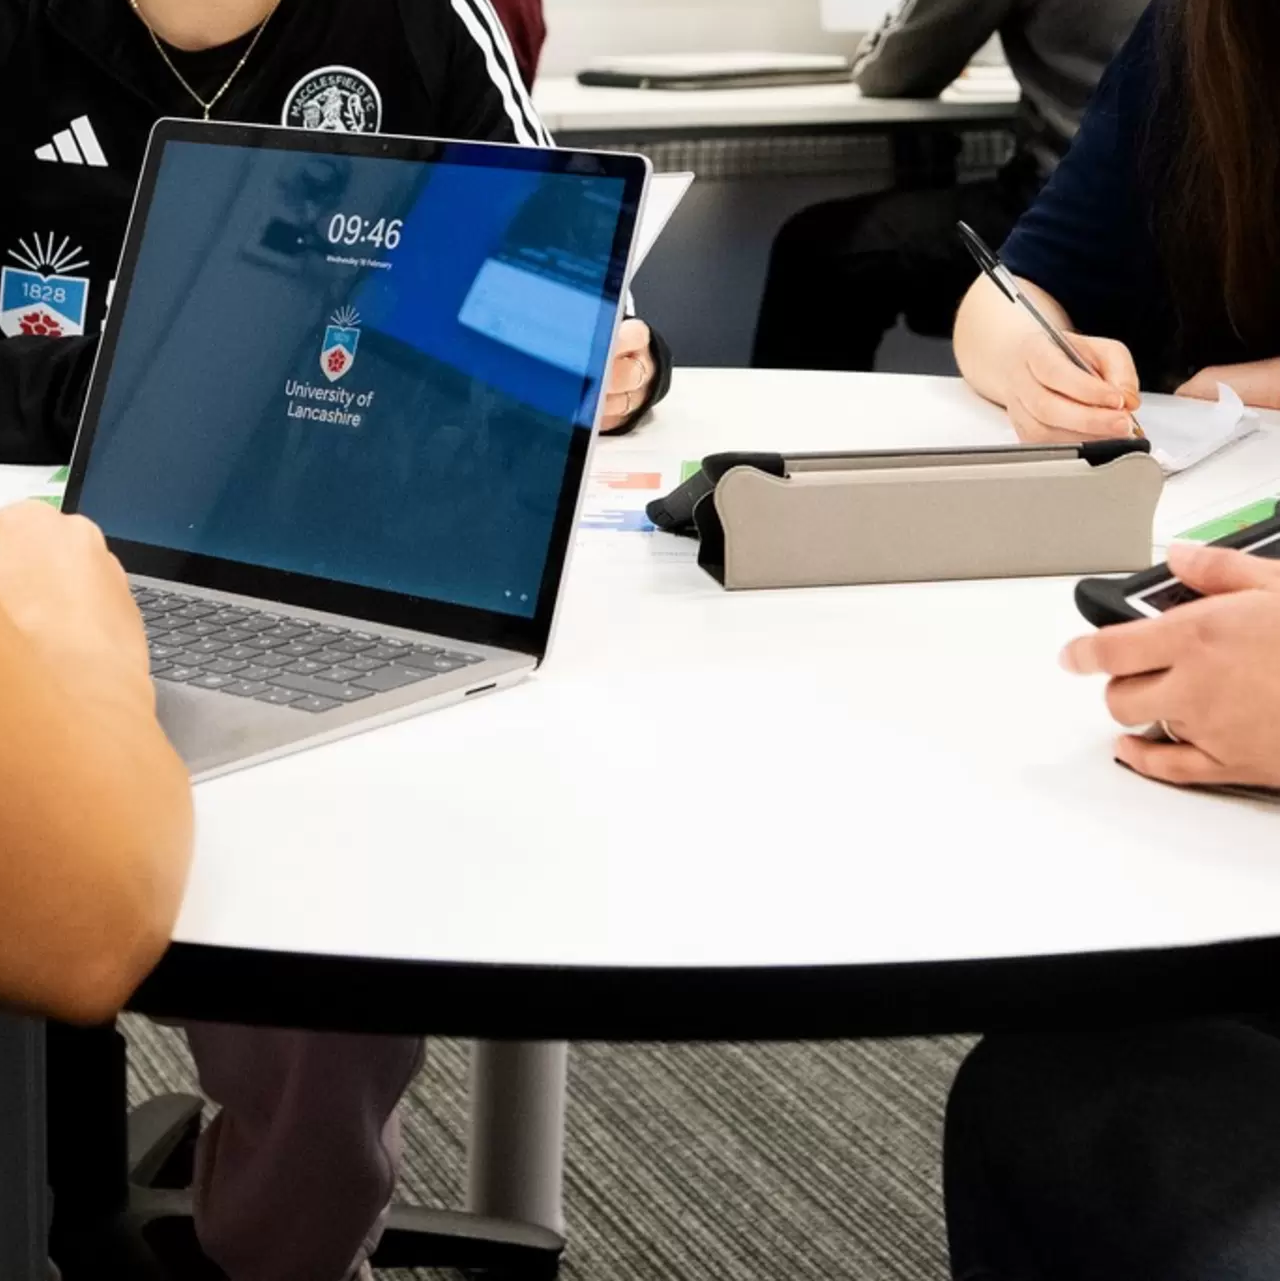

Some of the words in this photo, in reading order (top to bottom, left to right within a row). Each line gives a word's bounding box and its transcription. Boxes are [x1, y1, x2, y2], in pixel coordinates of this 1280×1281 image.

[290, 75, 366, 117] MACCLESFIELD
[363, 94, 375, 113] FC
[328, 212, 404, 250] 09:46
[22, 282, 66, 304] 1828
[285, 379, 355, 408] University
[357, 391, 375, 408] of
[287, 400, 362, 427] Lancashire
